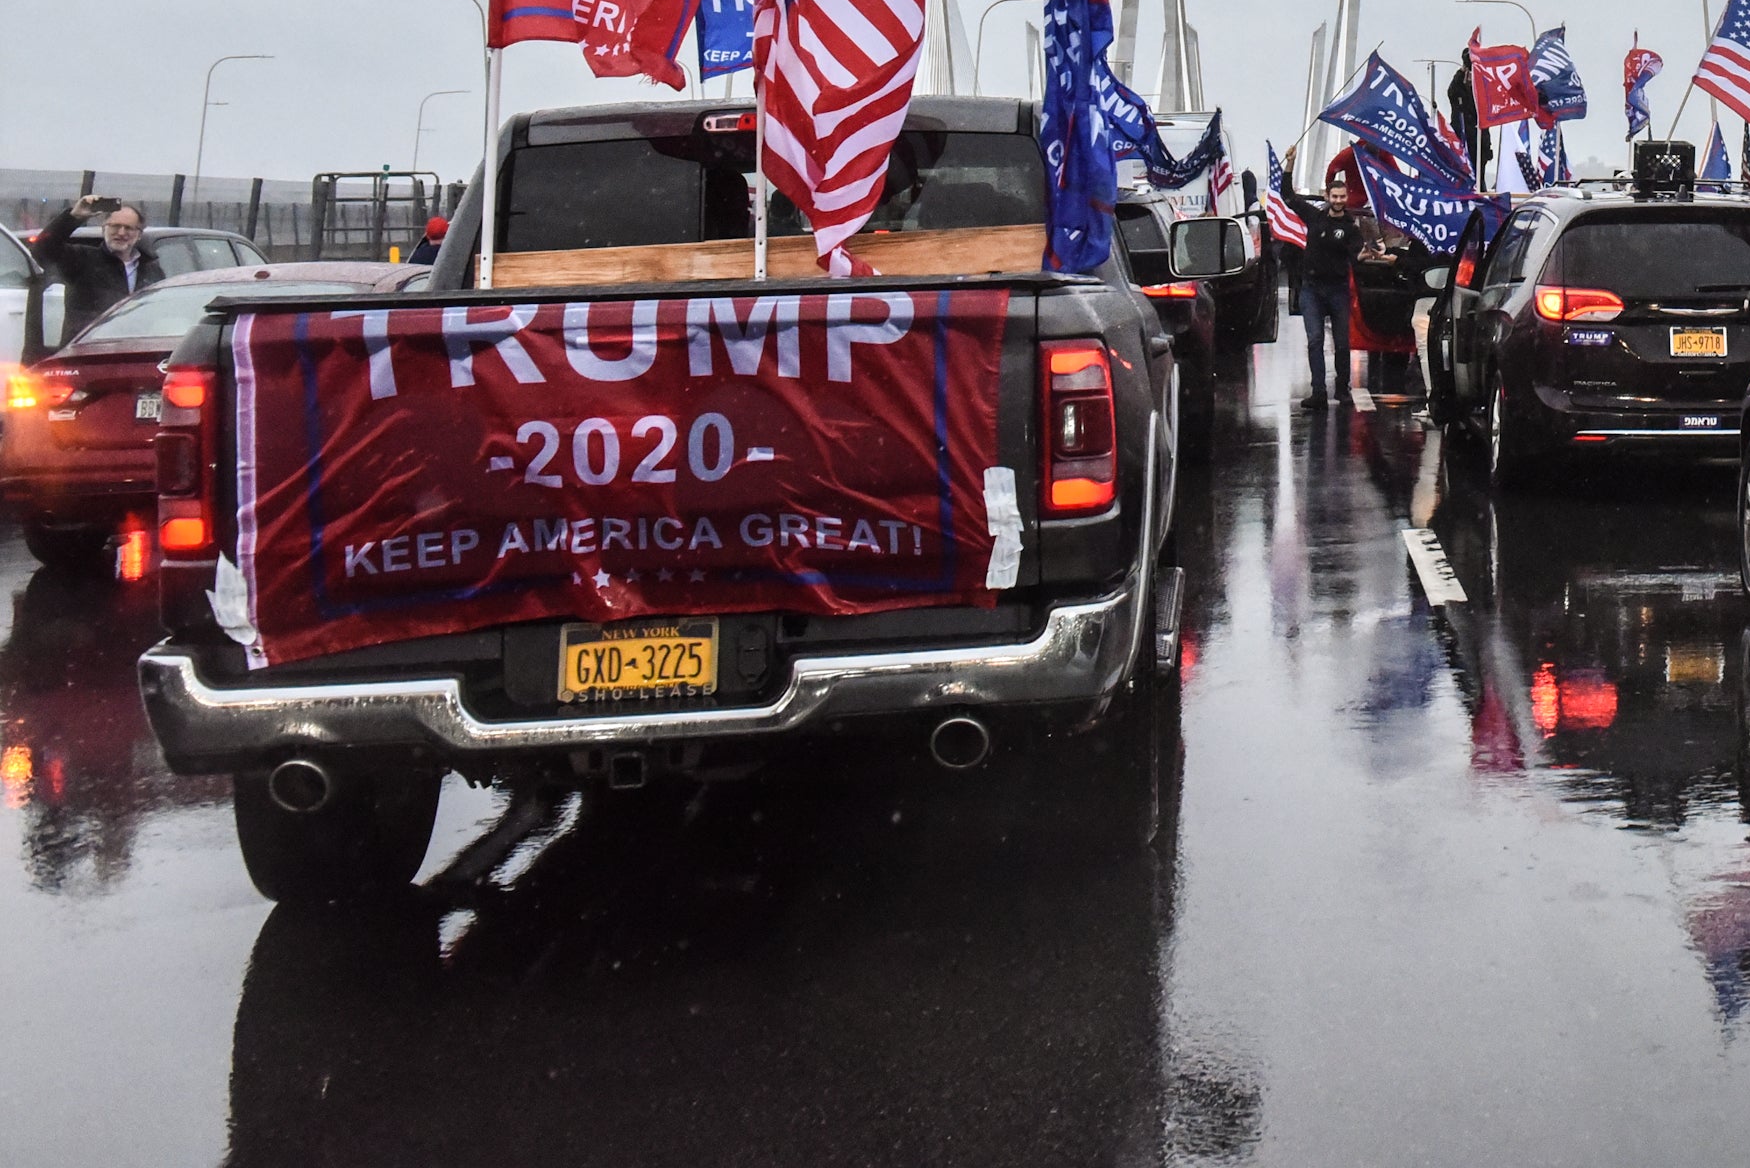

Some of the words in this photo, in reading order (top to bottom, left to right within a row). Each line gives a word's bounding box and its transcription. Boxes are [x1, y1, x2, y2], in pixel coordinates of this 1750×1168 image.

[1371, 123, 1418, 152] AMERICA
[1378, 110, 1431, 153] -2020-
[331, 292, 915, 400] TRUMP
[43, 369, 80, 377] ALTIMA
[489, 412, 774, 488] -2020-
[345, 529, 479, 578] KEEP
[497, 517, 722, 559] AMERICA
[739, 513, 922, 556] GREAT!
[602, 628, 636, 641] NEW
[642, 626, 680, 638] YORK
